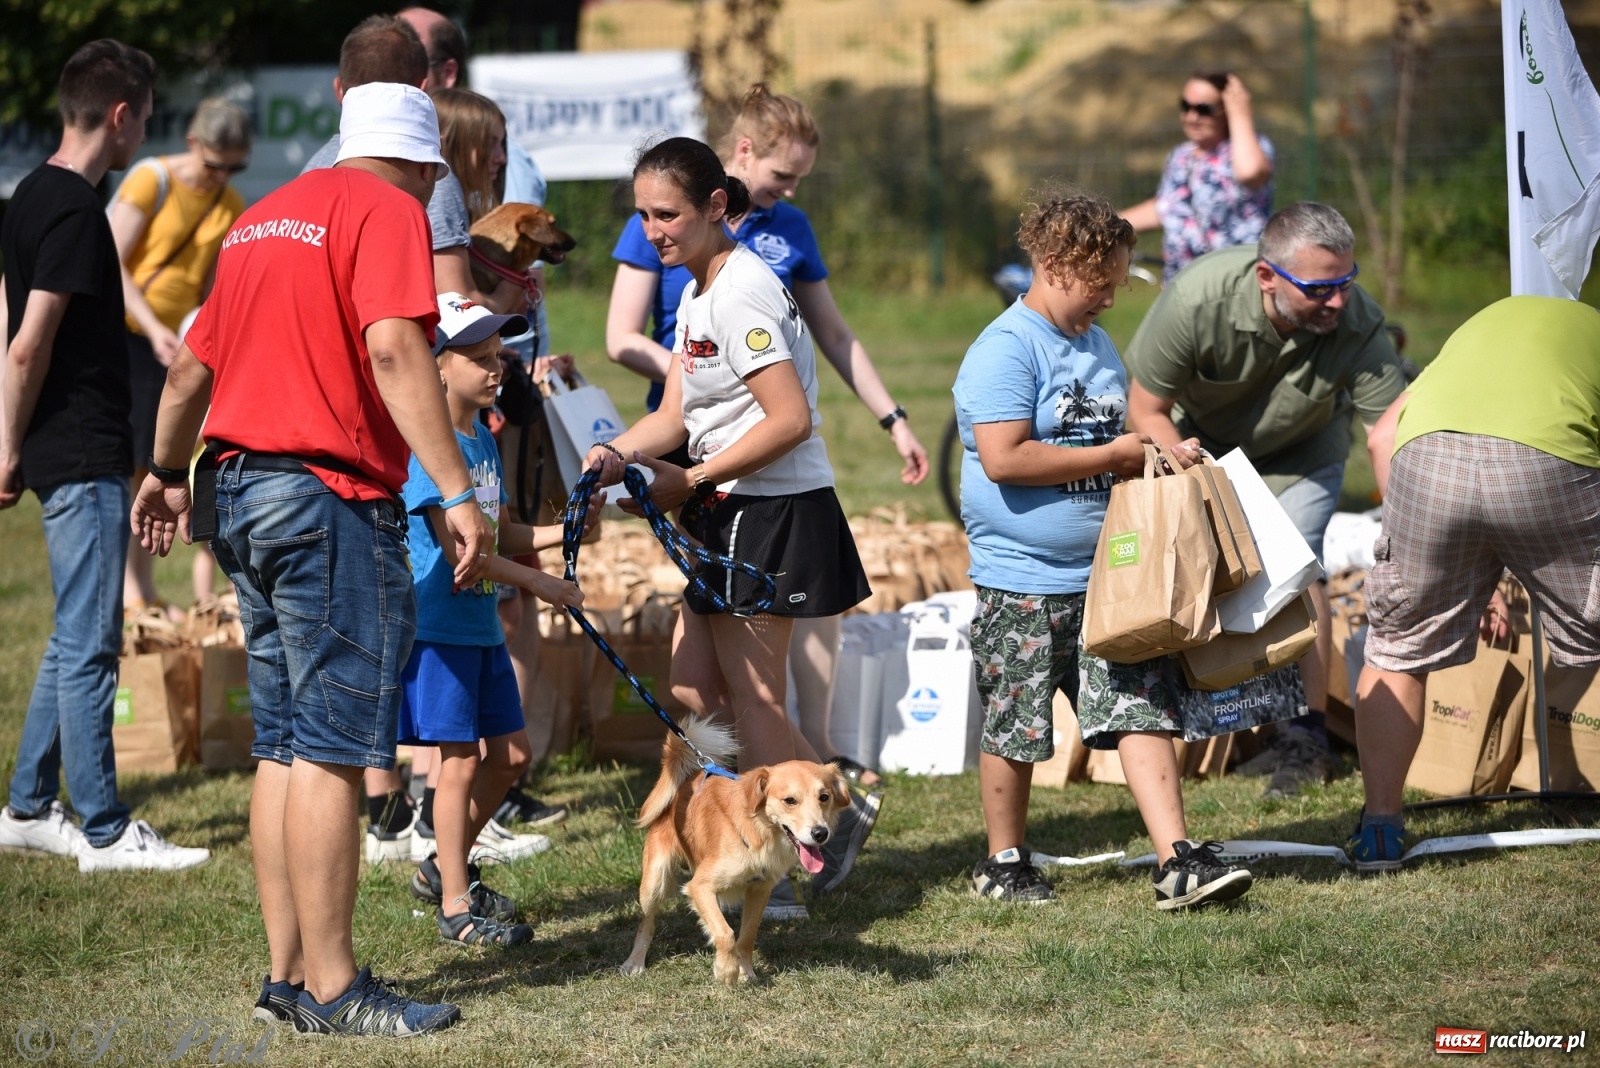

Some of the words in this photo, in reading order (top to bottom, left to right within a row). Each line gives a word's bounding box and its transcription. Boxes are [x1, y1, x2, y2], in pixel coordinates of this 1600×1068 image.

[1212, 692, 1229, 700] SPOT
[1230, 688, 1240, 697] ON
[1432, 700, 1471, 721] TropiCat
[1548, 706, 1600, 731] TropiDog
[1217, 713, 1239, 725] SPRAY
